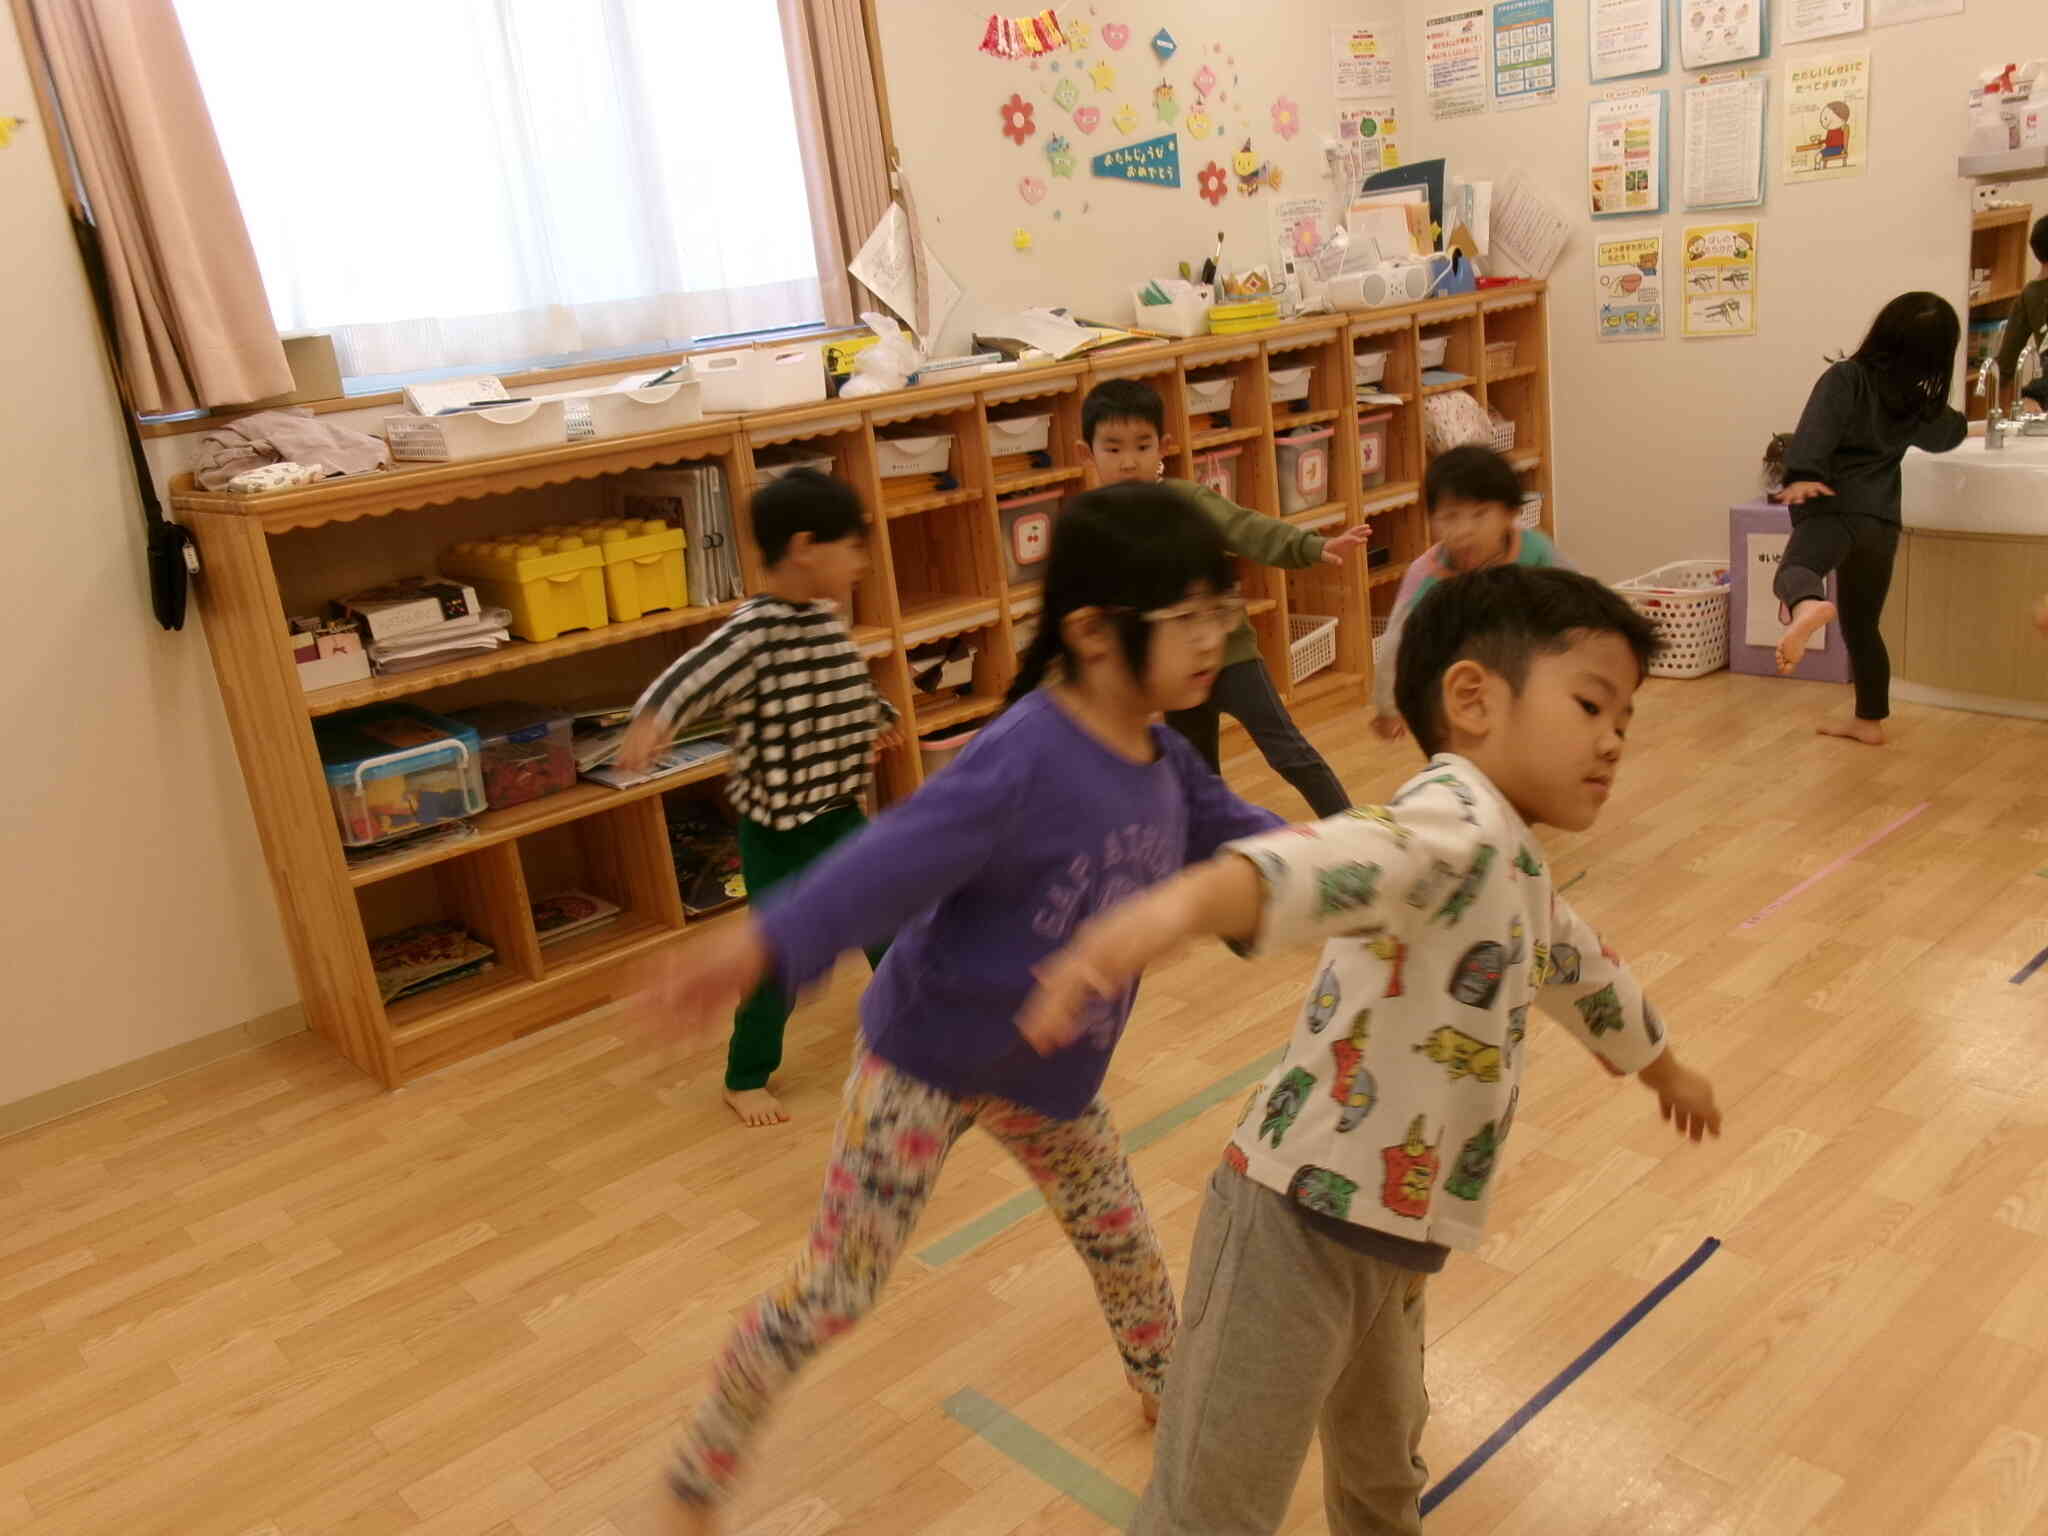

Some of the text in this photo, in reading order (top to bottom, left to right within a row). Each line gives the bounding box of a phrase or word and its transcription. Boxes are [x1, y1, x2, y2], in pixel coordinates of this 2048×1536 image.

[1791, 62, 1863, 81] ただしいしせいで
[1104, 143, 1164, 167] おたんじょうび
[1127, 165, 1173, 180] おめでとう
